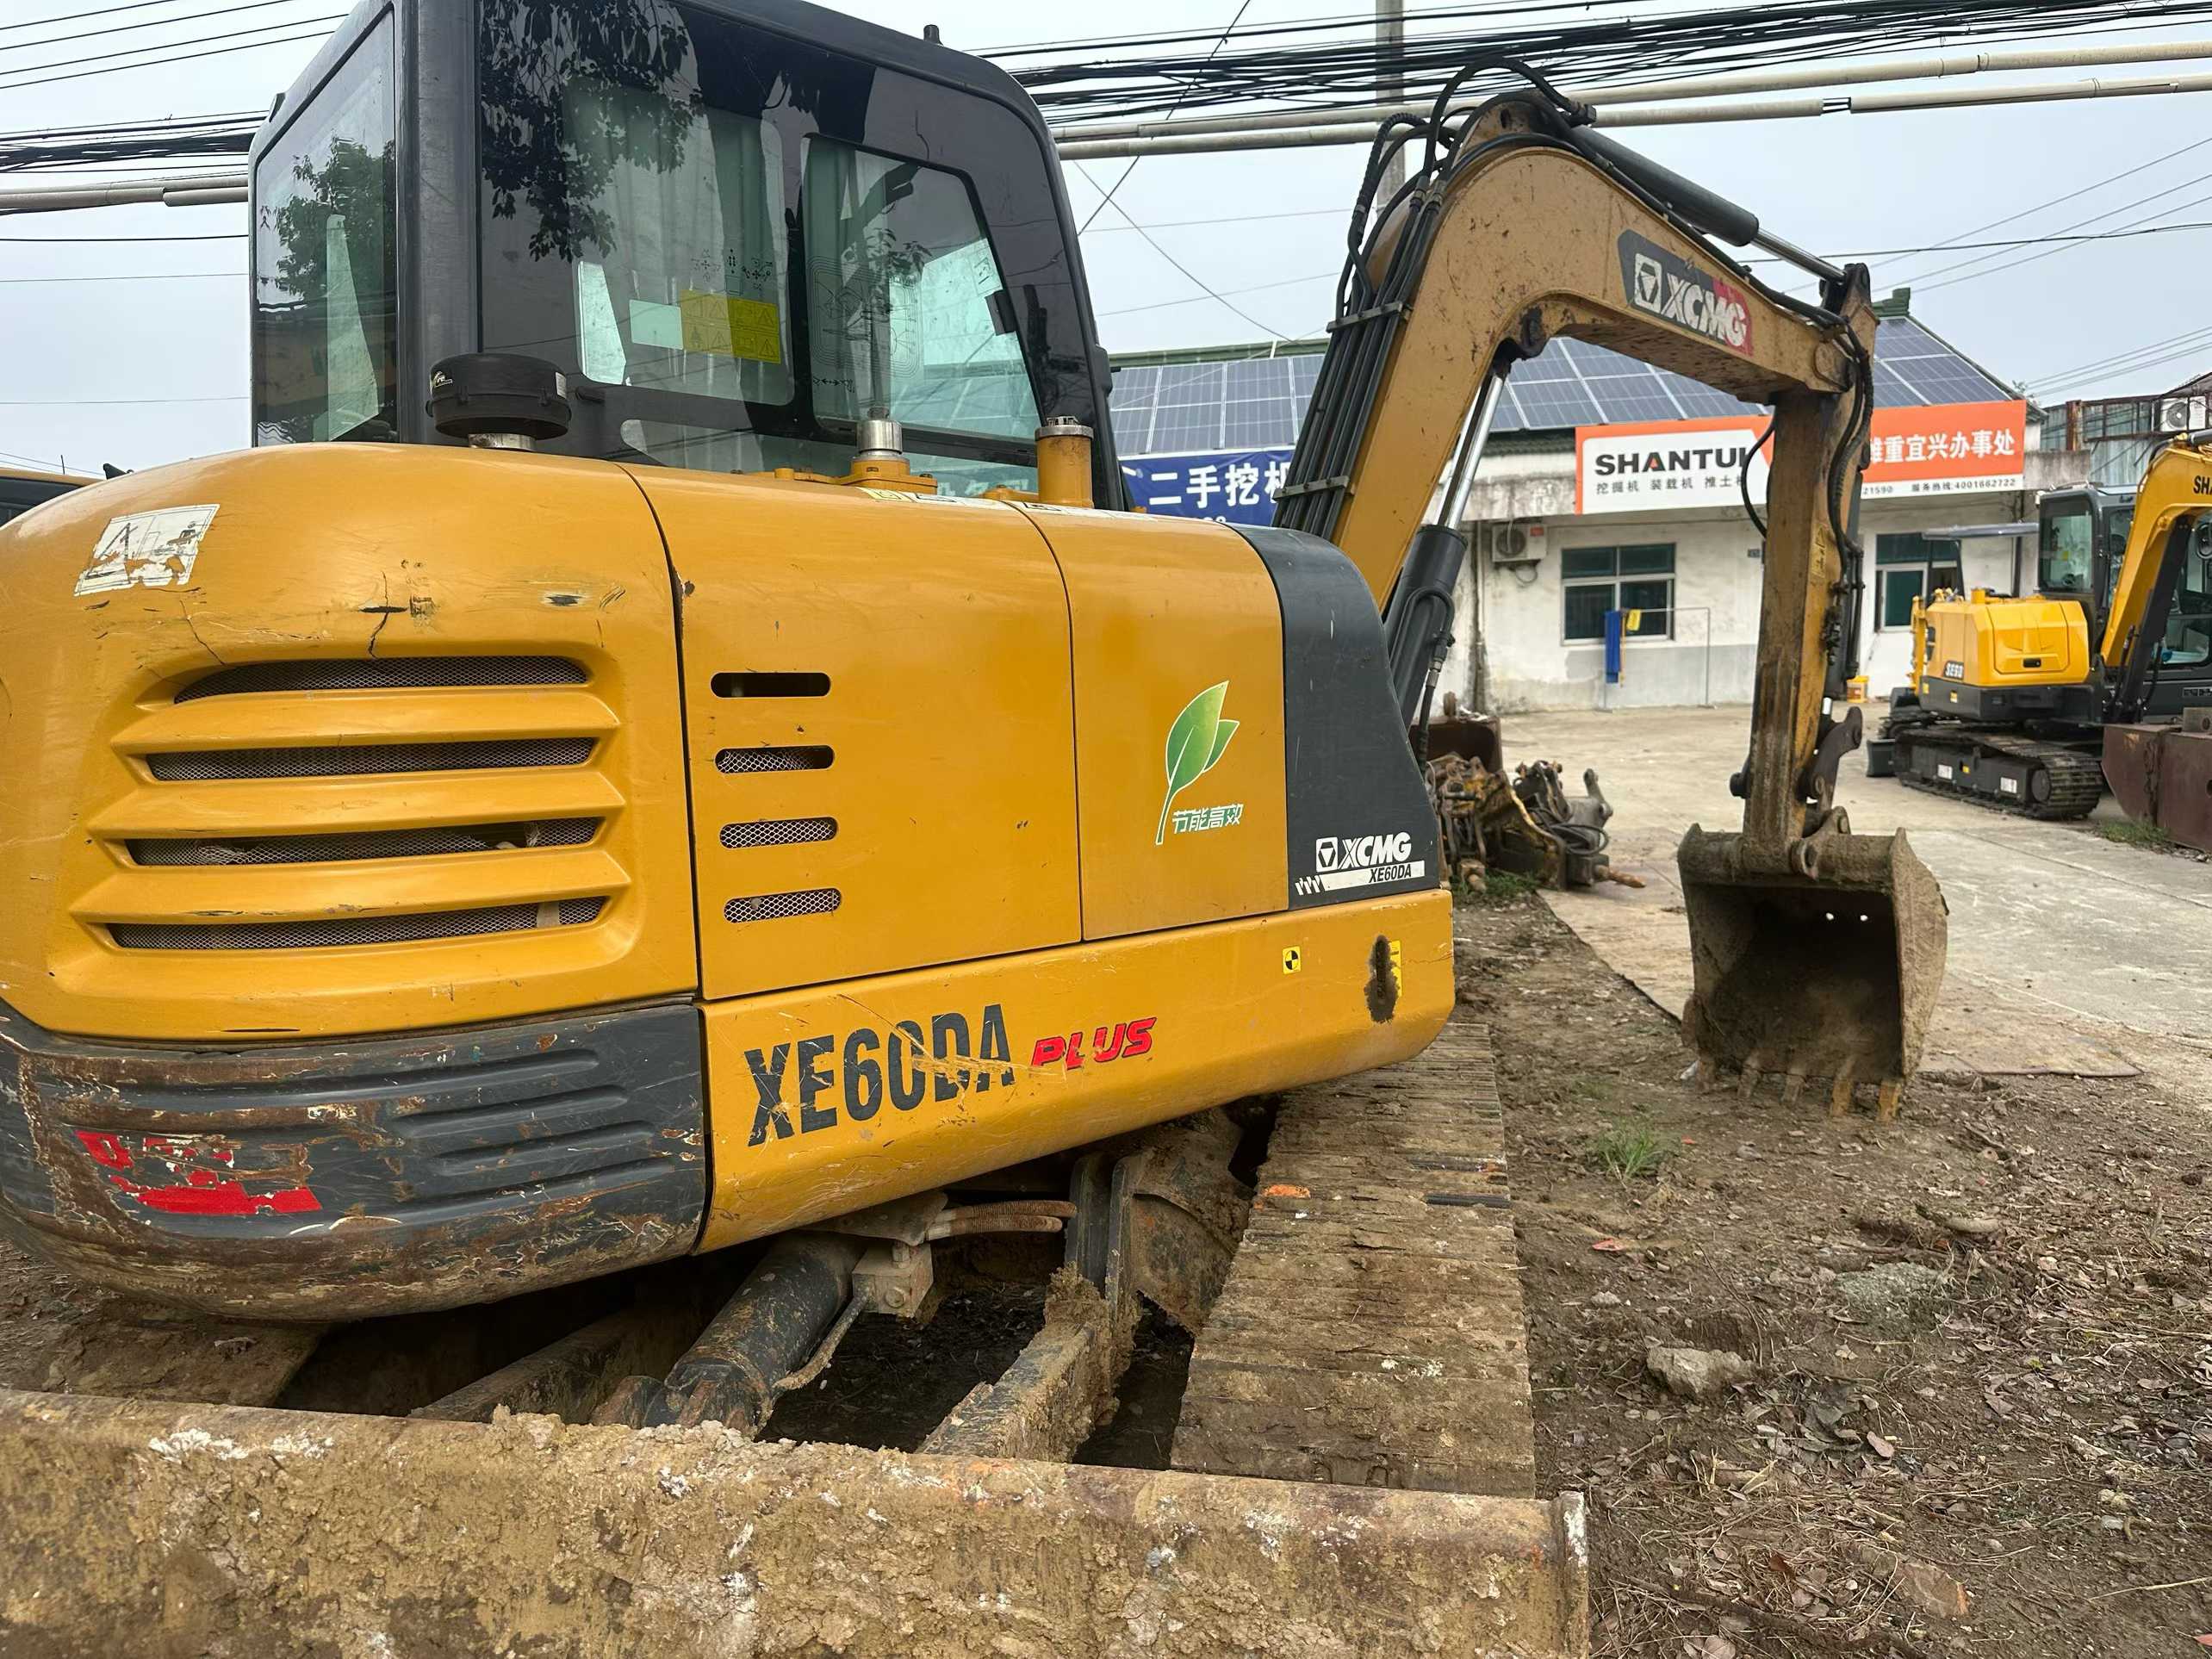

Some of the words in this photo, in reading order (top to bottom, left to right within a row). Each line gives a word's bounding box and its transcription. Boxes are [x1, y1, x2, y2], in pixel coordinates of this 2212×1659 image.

[1661, 272, 1747, 347] XCMG
[1594, 447, 1746, 475] SHANTUI
[1148, 461, 1291, 508] 二手挖机
[1596, 481, 1639, 494] 挖掘机
[1650, 477, 1693, 491] 装载机
[2193, 475, 2212, 495] SH
[1171, 804, 1244, 834] 节能高效
[1337, 831, 1412, 870] XCMG
[1368, 863, 1412, 884] XE60DA
[743, 1003, 1015, 1147] XE60DA
[1030, 1016, 1157, 1071] PLUS
